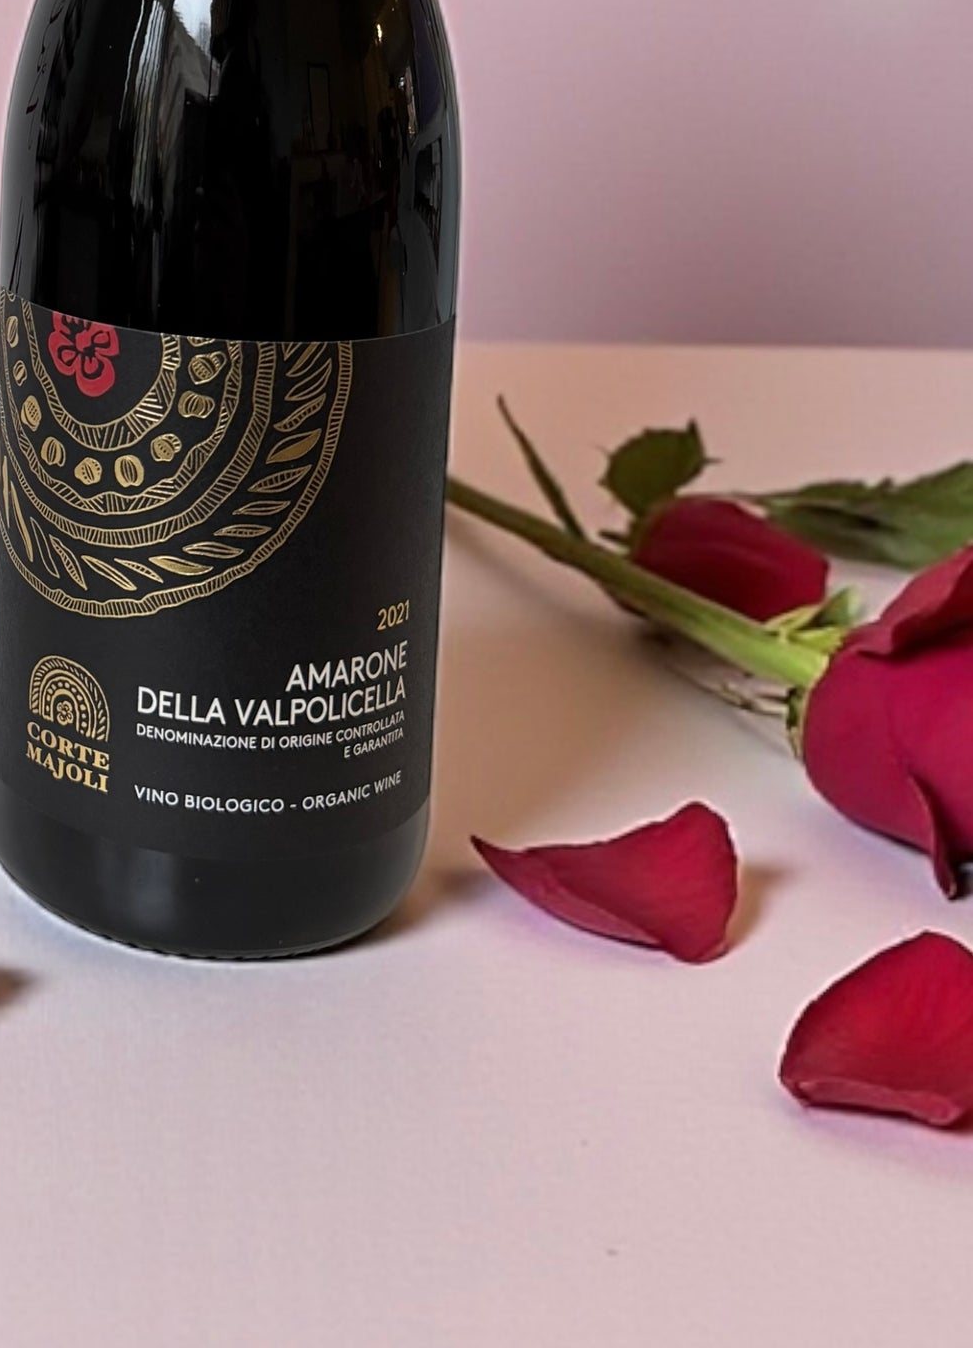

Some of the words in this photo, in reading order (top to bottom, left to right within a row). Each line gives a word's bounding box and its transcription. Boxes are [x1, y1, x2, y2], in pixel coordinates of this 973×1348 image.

[377, 599, 410, 631] 2021
[285, 640, 408, 692] AMARONE
[137, 685, 226, 725] DELLA
[234, 676, 407, 726] VALPOLICELLA
[26, 721, 110, 771] CORTE
[136, 722, 257, 749] DENOMINAZIONE
[261, 736, 275, 749] DI
[278, 731, 332, 749] ORIGINE
[335, 710, 405, 743] CONTROLLATA
[344, 745, 351, 758] E
[352, 727, 404, 756] GARANTITA
[25, 741, 109, 793] MAJOLI
[134, 785, 179, 806] VINO
[184, 794, 285, 813] BIOLOGICO
[301, 784, 371, 811] ORGANIC
[373, 770, 402, 795] WINE
